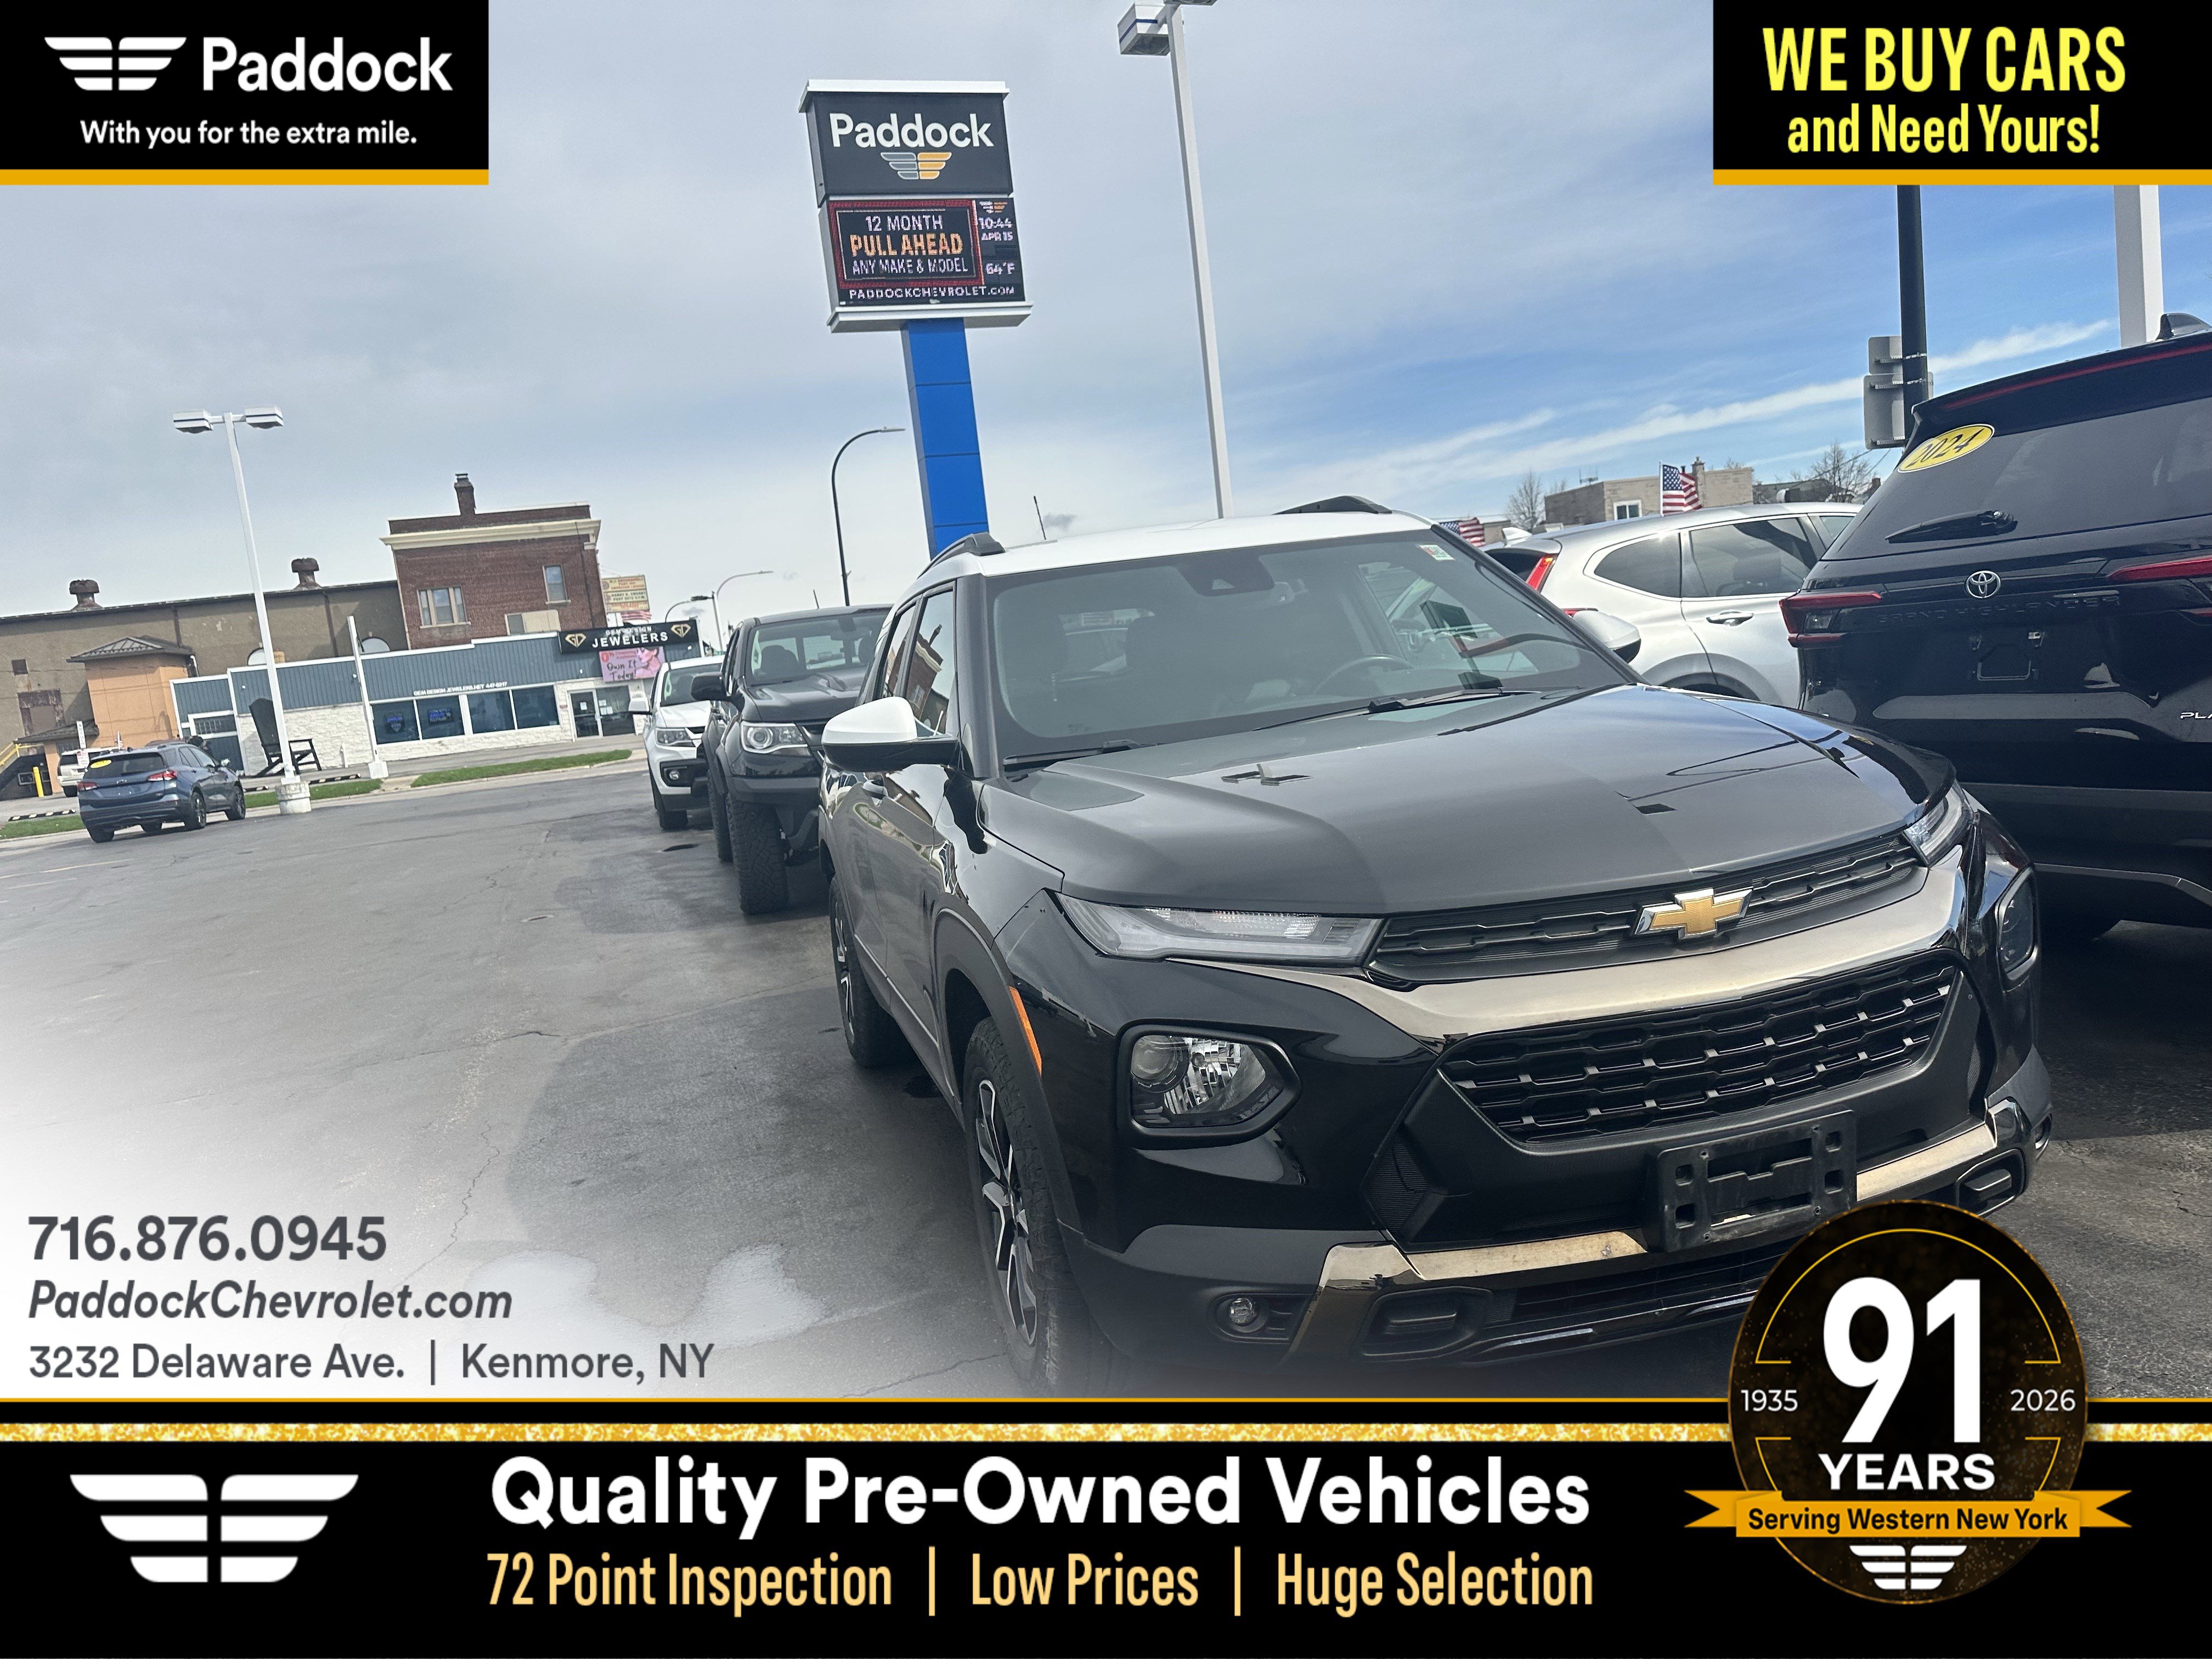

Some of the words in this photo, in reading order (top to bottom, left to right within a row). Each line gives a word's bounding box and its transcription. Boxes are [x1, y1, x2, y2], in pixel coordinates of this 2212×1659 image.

[829, 113, 994, 148] Paddock
[865, 216, 882, 232] 12
[888, 215, 943, 231] MONTH
[979, 217, 1013, 230] 10:44
[850, 234, 897, 257] PULL
[901, 233, 963, 256] AHEAD
[1004, 232, 1014, 241] 15
[853, 259, 876, 275] ANY
[879, 258, 913, 274] MAKE
[917, 259, 924, 273] &
[928, 257, 968, 273] MODEL
[850, 285, 1014, 300] PADDOCKCHEVROLET.COM
[1905, 428, 1984, 469] 2024
[592, 631, 669, 648] JEWELERS
[607, 662, 625, 672] Own
